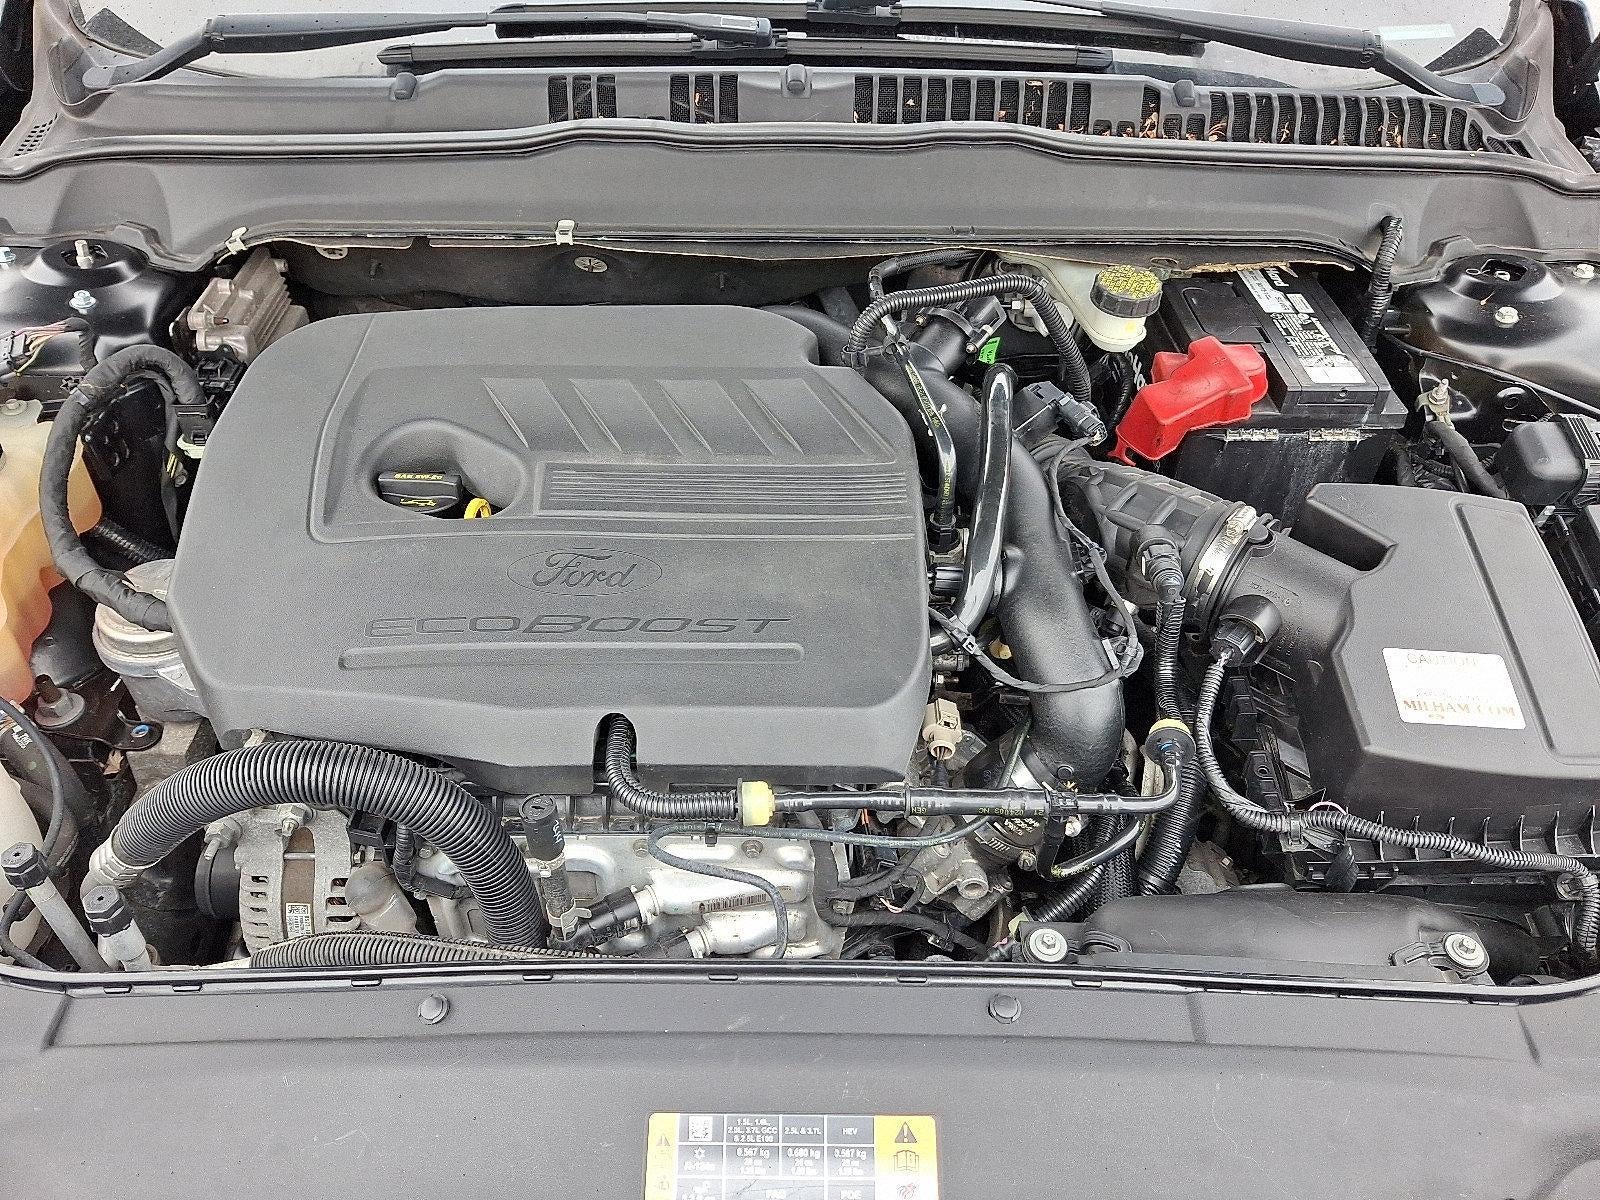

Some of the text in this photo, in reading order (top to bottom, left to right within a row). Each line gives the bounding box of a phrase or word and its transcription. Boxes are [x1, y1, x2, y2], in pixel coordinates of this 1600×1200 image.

[532, 552, 638, 588] Ford
[1403, 700, 1515, 716] MILHAMCOM
[760, 1147, 770, 1159] kg
[810, 1148, 821, 1159] kg
[856, 1149, 867, 1160] kg
